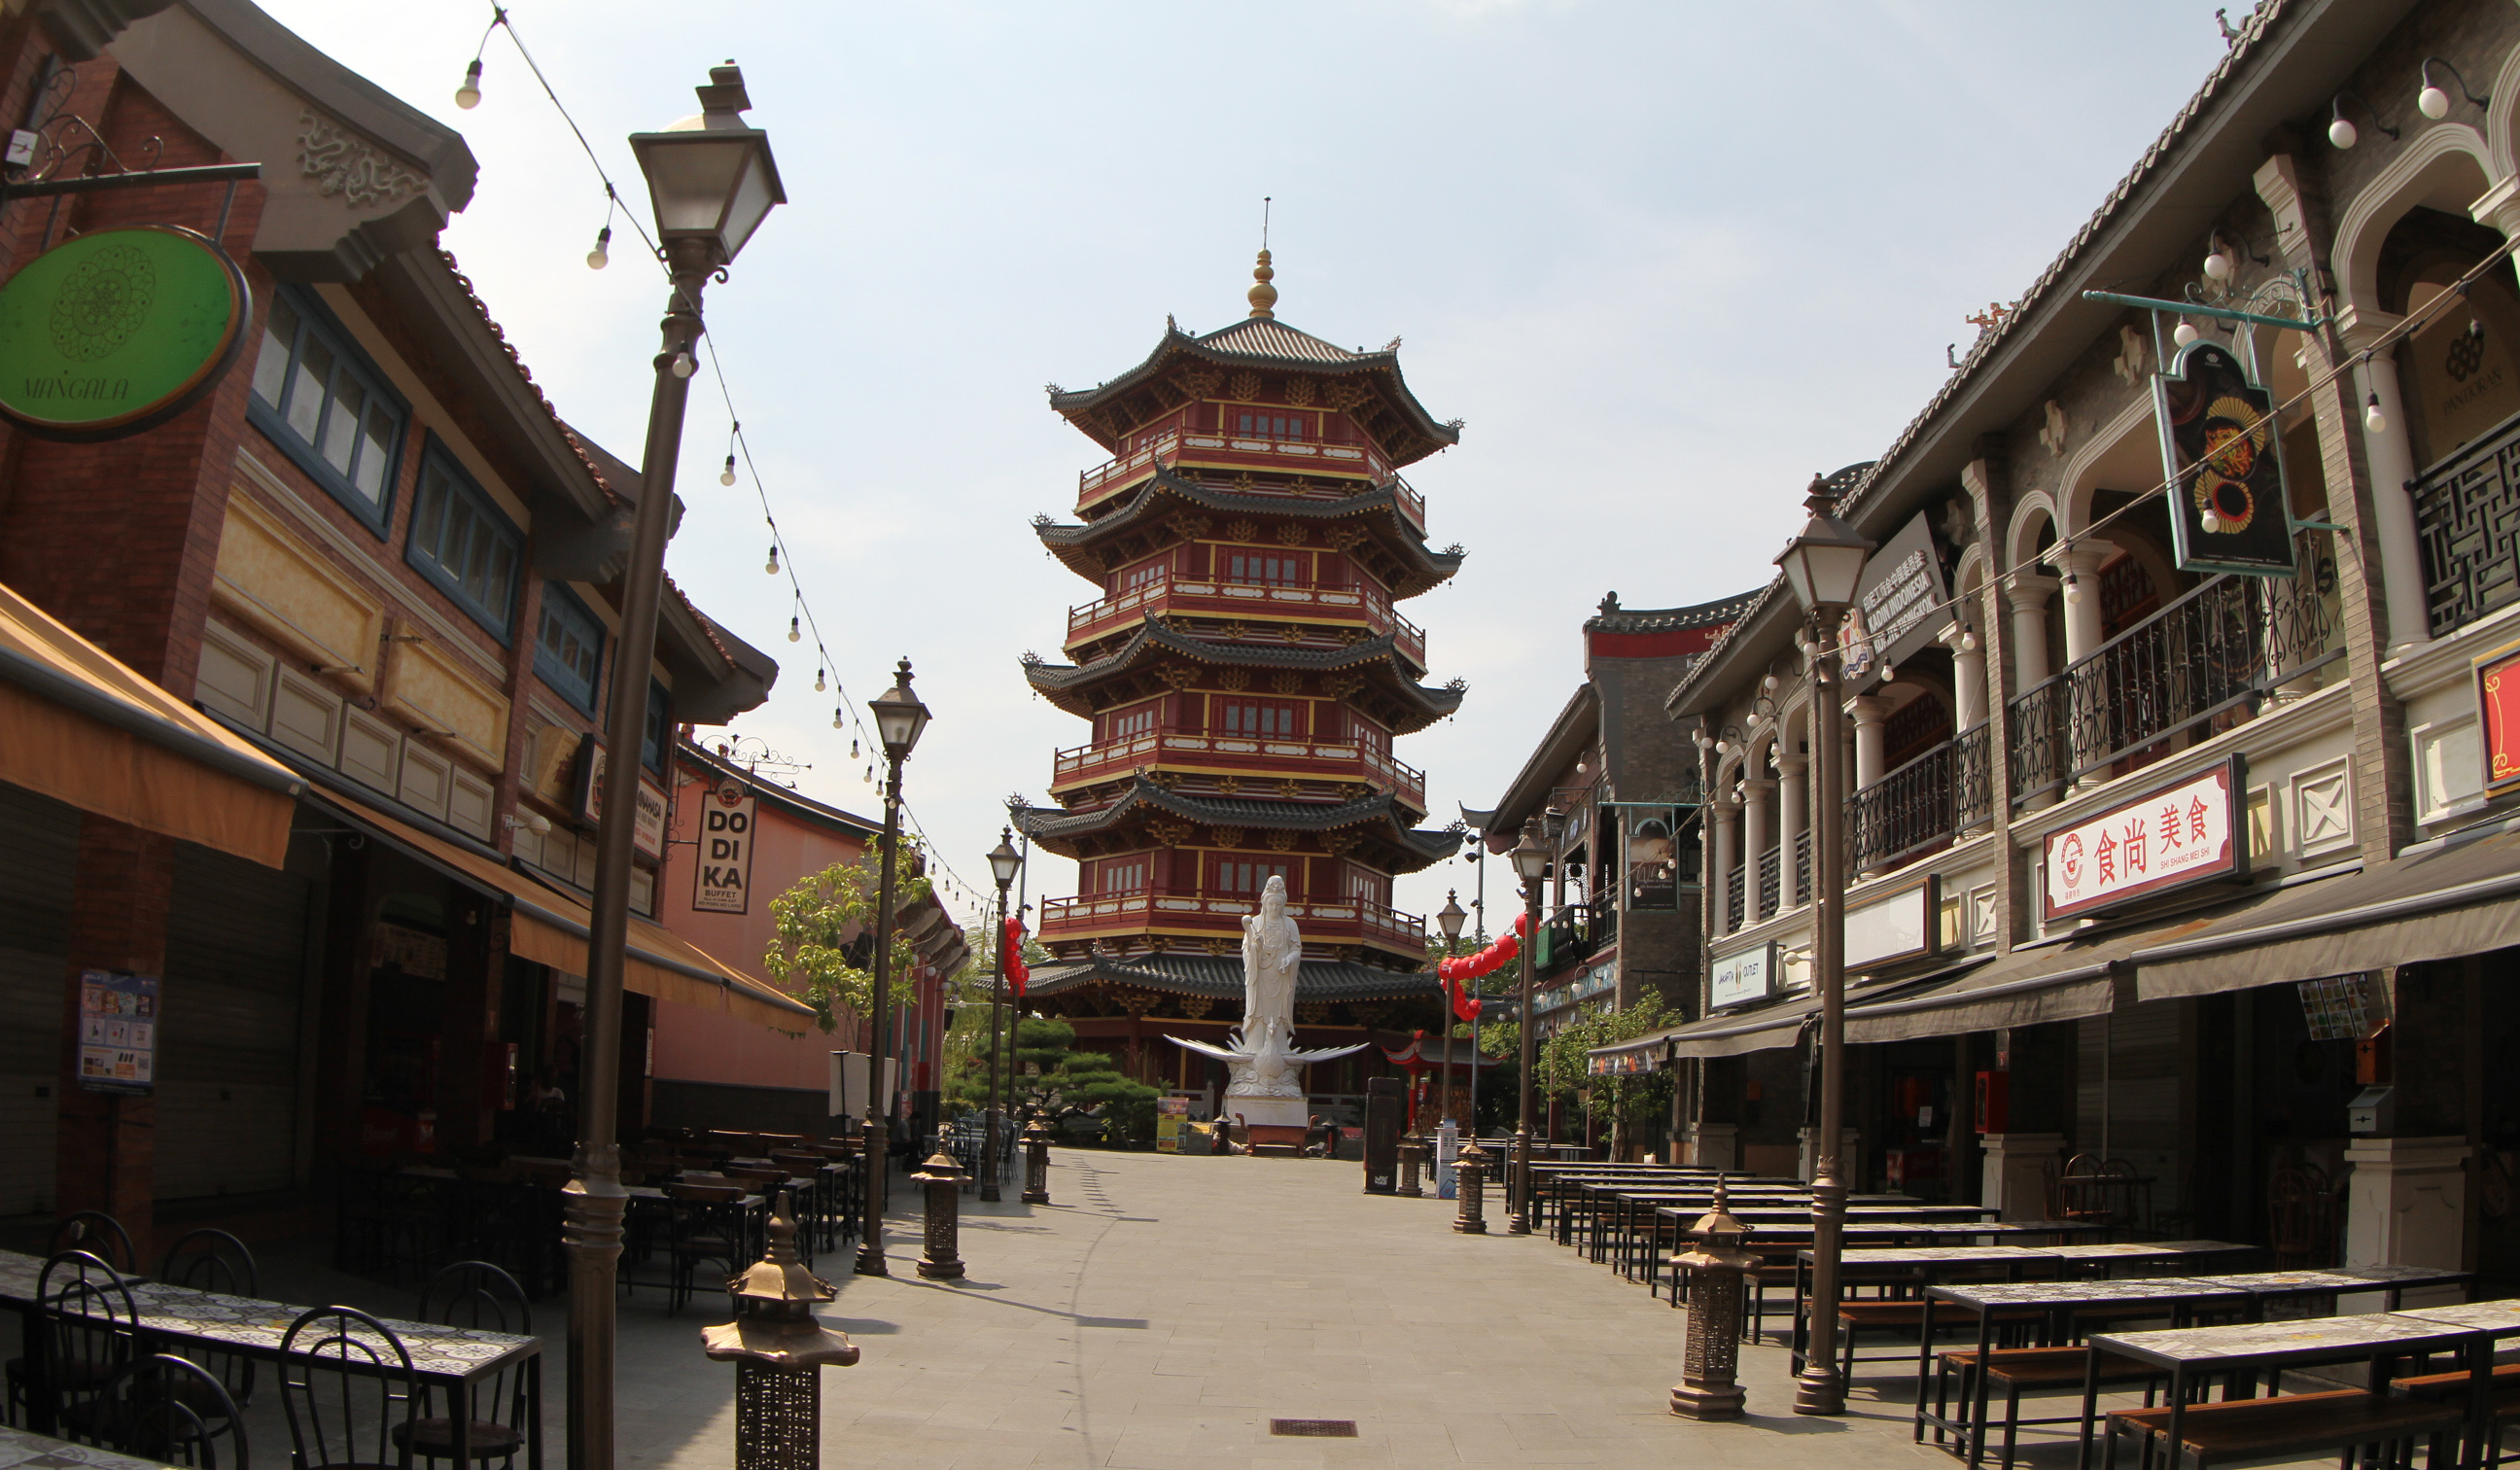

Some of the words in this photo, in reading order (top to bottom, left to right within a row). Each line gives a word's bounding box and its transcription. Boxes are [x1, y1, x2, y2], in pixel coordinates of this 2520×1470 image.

[24, 378, 129, 400] MANGALA
[1867, 602, 1892, 634] KADIN
[1887, 571, 1930, 616] INDONESIA
[708, 811, 748, 834] DO
[712, 838, 739, 861] DI
[2094, 818, 2147, 887] 食尚
[2159, 794, 2209, 855] 美食
[2160, 859, 2169, 870] SHI
[2170, 854, 2189, 866] SHANG
[2189, 850, 2199, 860] MEI
[2200, 847, 2210, 858] SHI
[703, 865, 743, 890] KA
[705, 890, 737, 898] BUFFET
[1743, 962, 1759, 978] OUTLET
